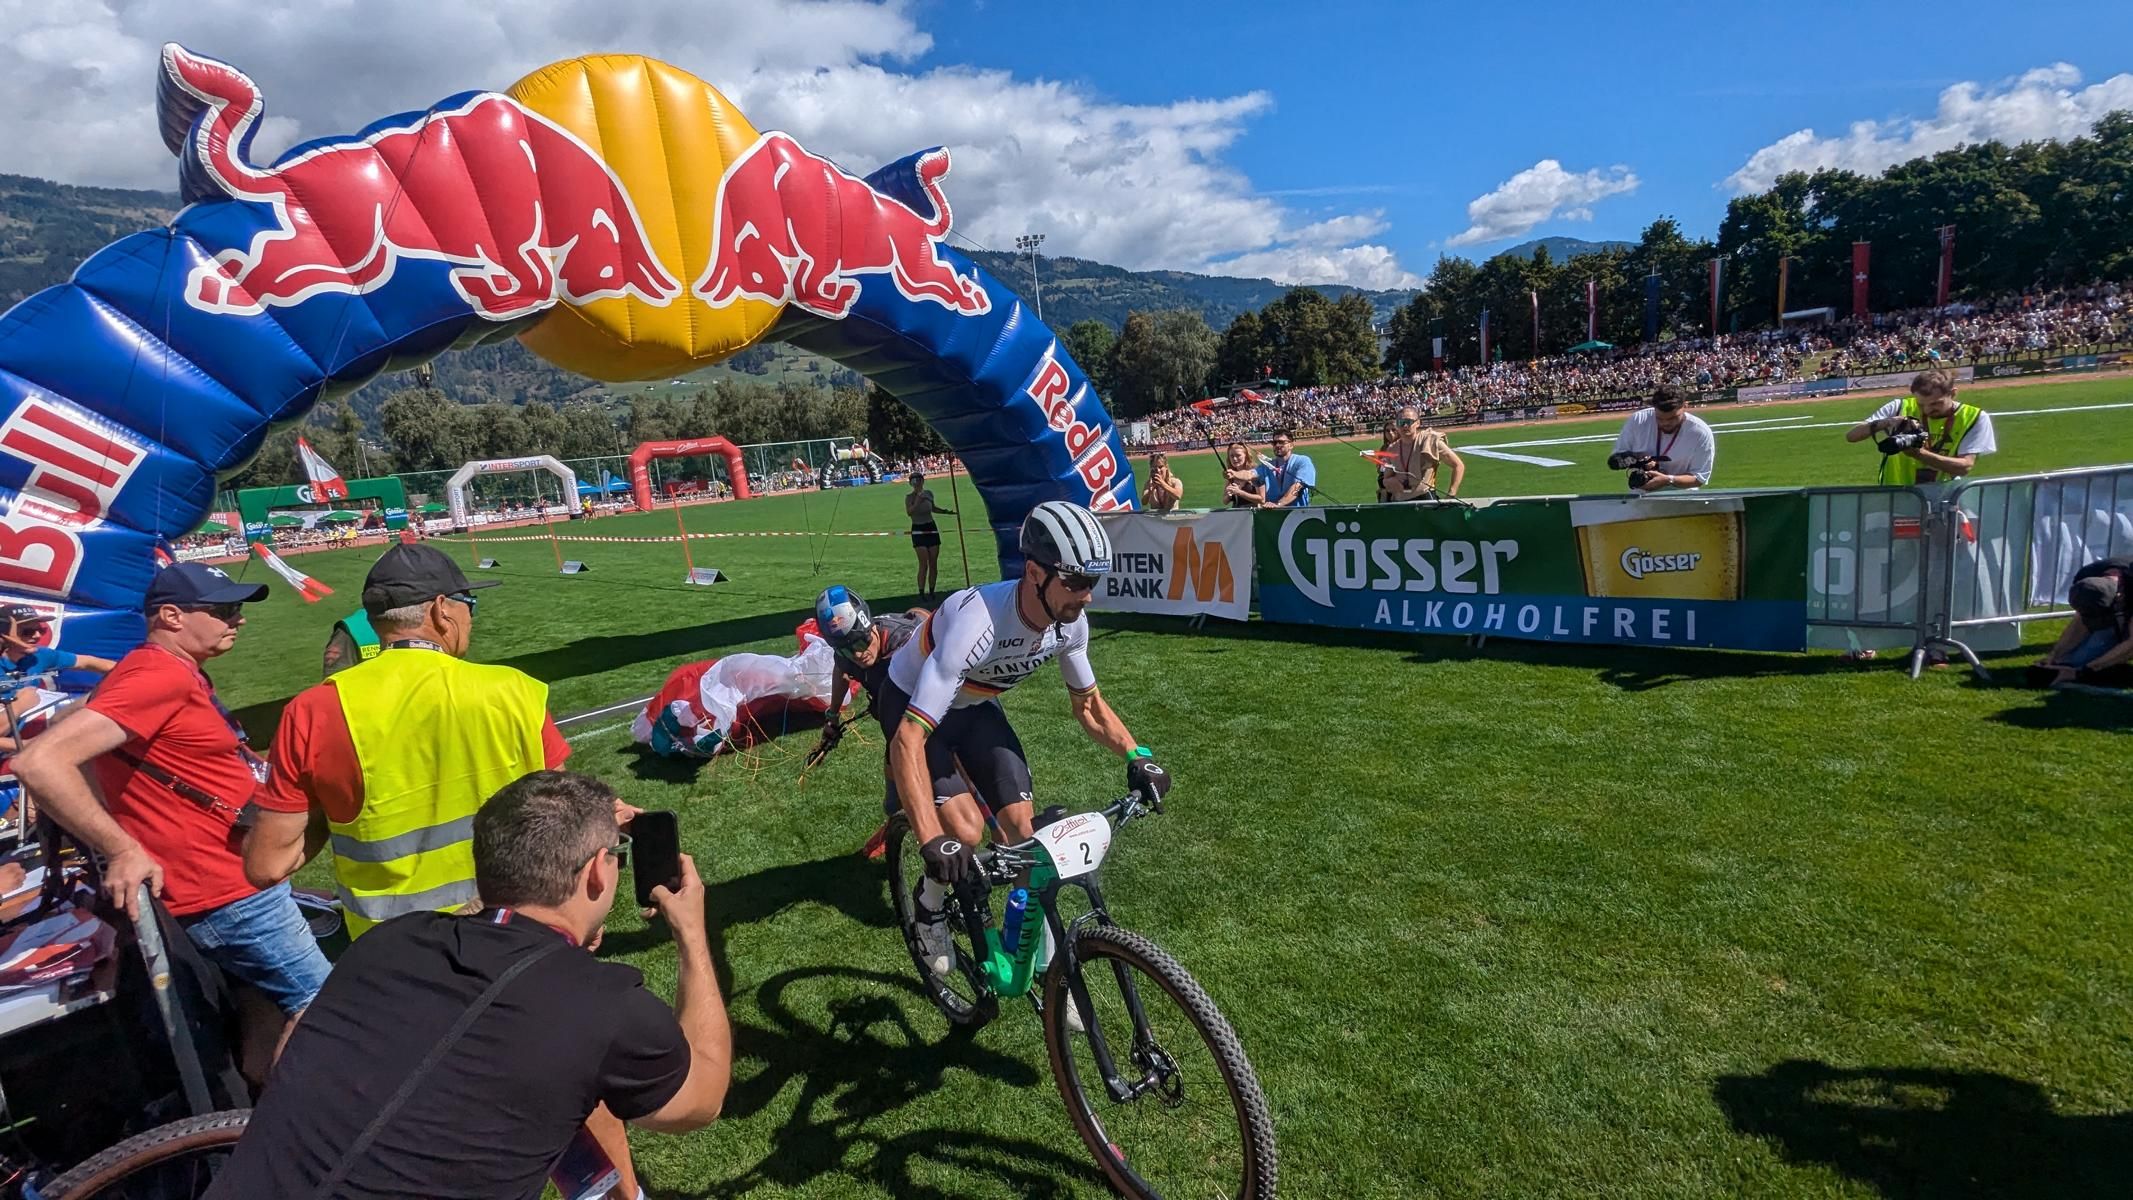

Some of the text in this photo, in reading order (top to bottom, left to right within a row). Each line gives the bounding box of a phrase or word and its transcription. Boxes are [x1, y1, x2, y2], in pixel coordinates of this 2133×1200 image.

[488, 459, 541, 471] INTERSPORT
[1088, 561, 1110, 569] pure
[1278, 509, 1519, 607] Gösser
[1621, 546, 1701, 579] Gösser
[1107, 577, 1164, 600] BANK
[1374, 598, 1696, 641] ALKOHOLFREI
[1002, 638, 1024, 648] UCI
[1052, 815, 1089, 840] Osttirol
[1079, 842, 1093, 866] 2
